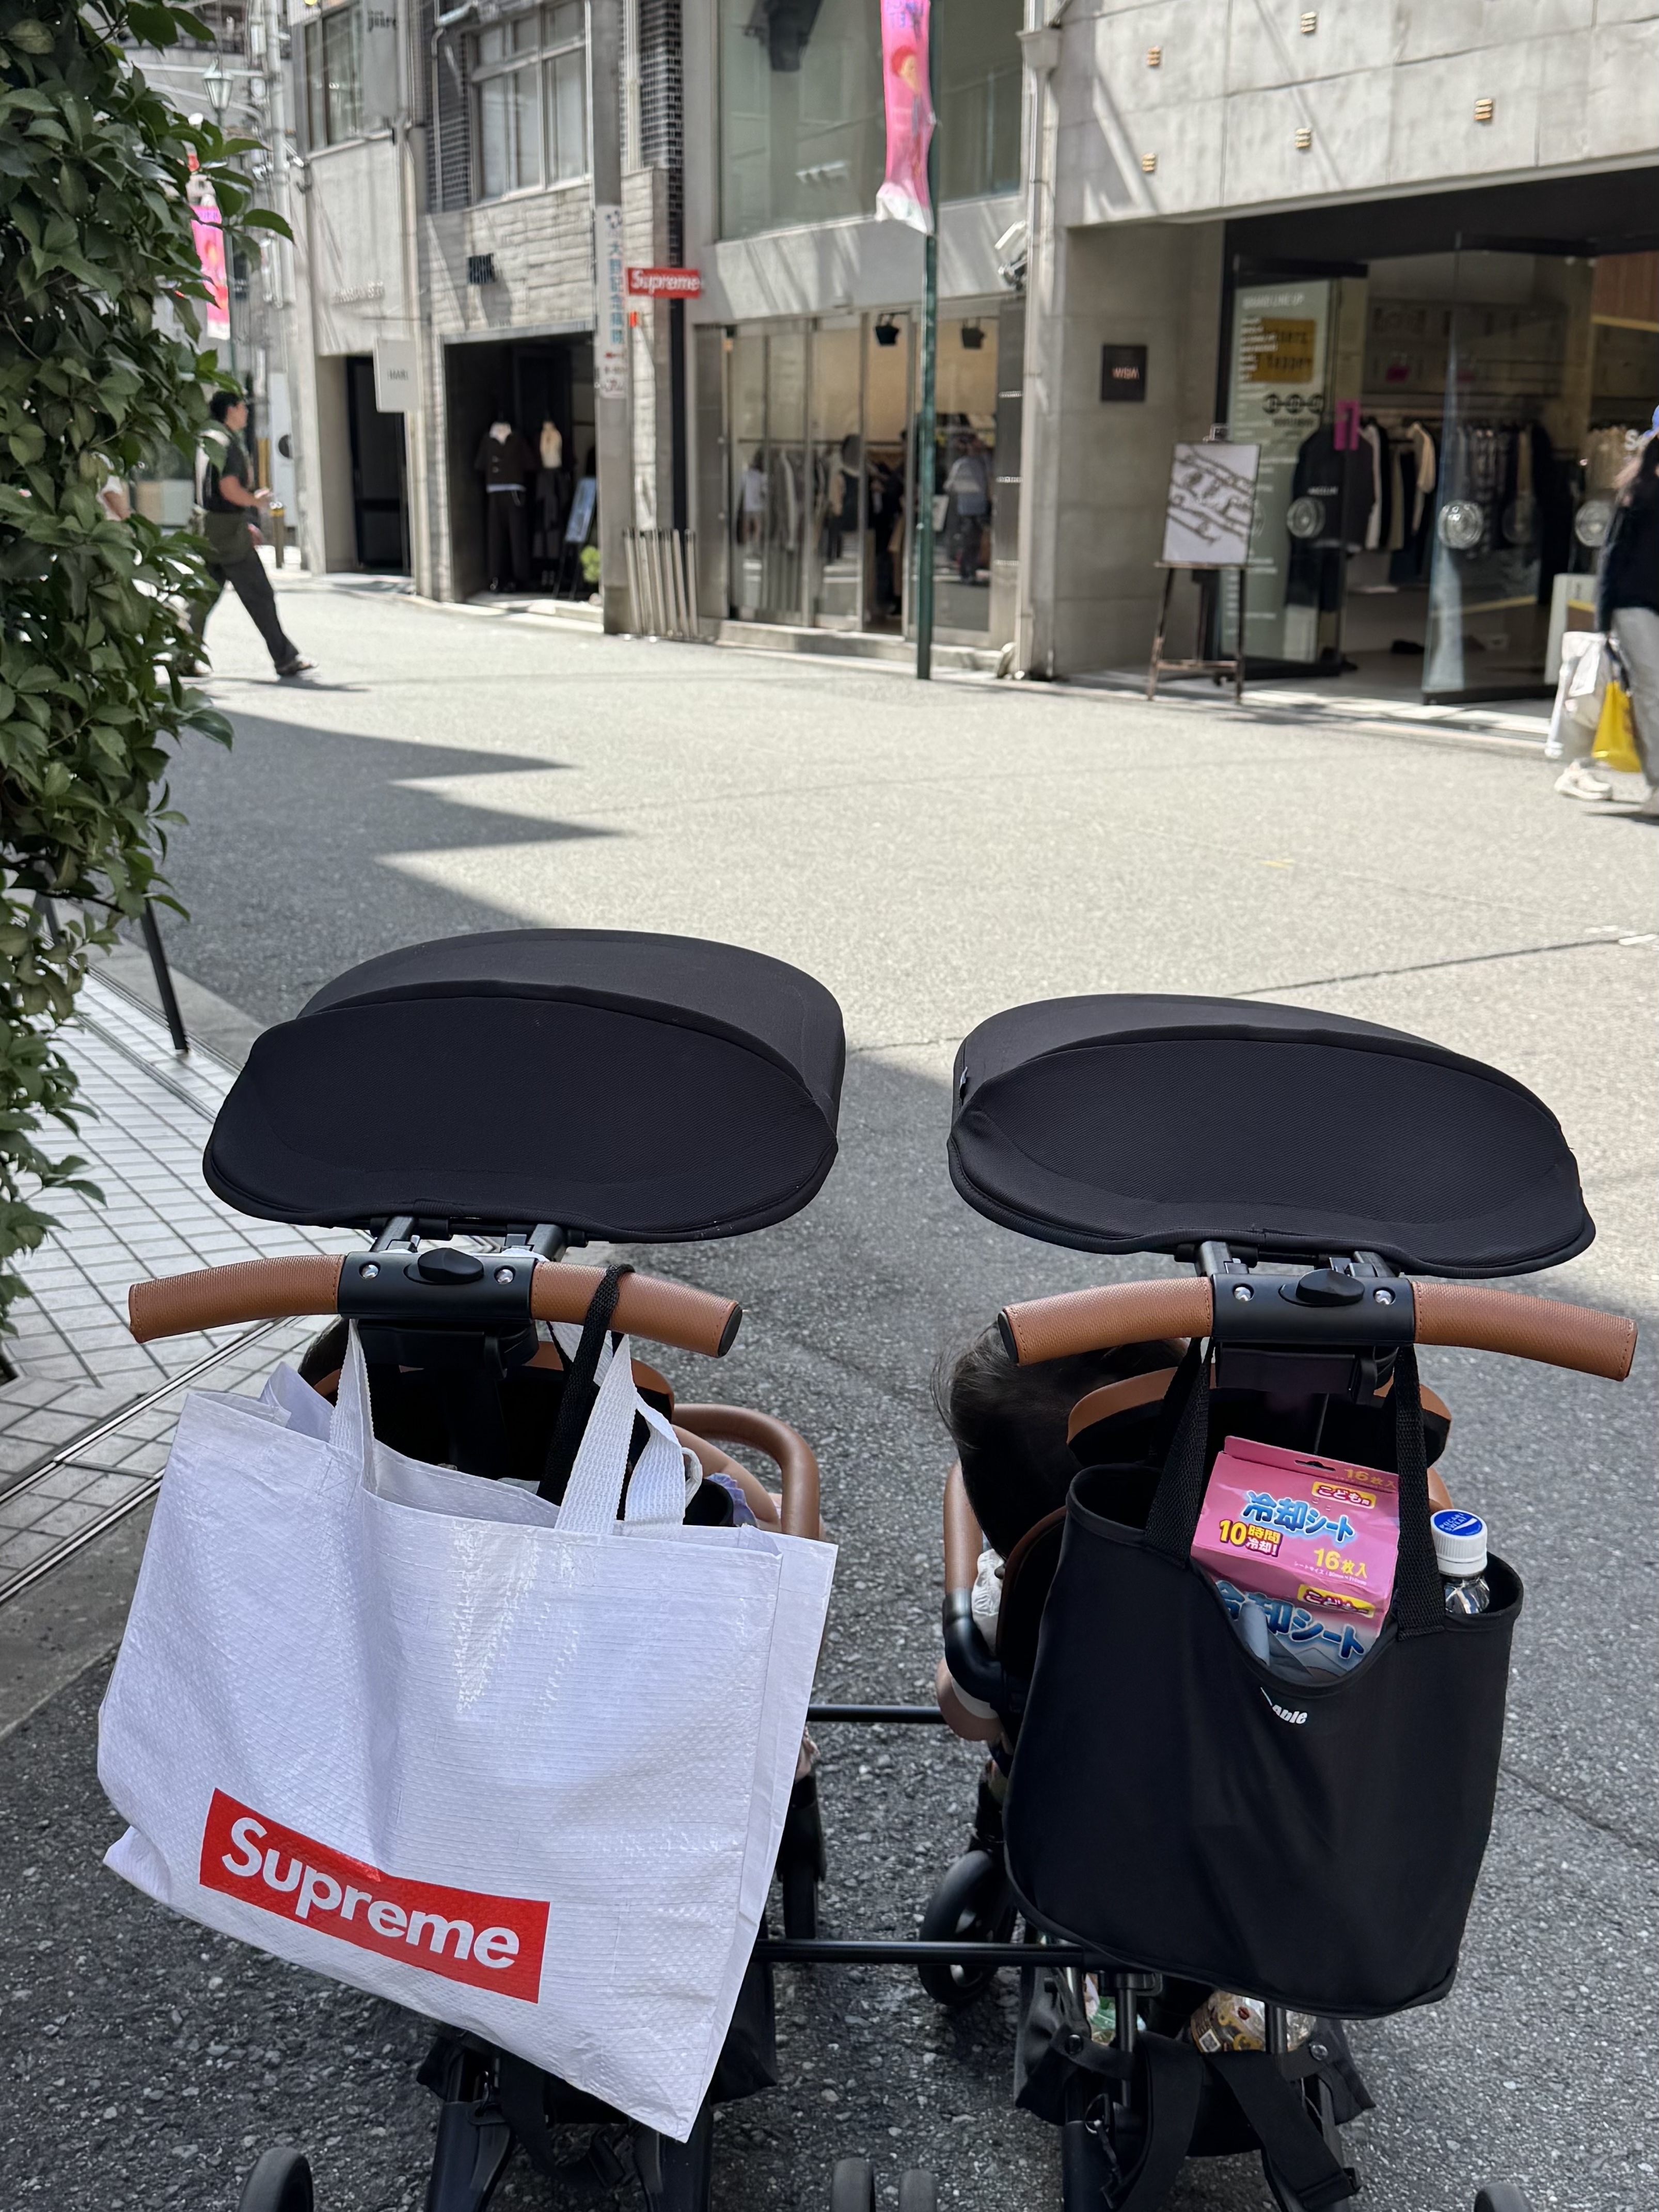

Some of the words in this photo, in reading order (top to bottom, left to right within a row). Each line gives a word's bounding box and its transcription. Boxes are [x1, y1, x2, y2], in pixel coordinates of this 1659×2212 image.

[631, 269, 700, 295] Supreme
[1242, 1490, 1354, 1542] 冷却シート
[1314, 1548, 1368, 1578] 16枚入
[222, 1816, 519, 1968] Supreme
